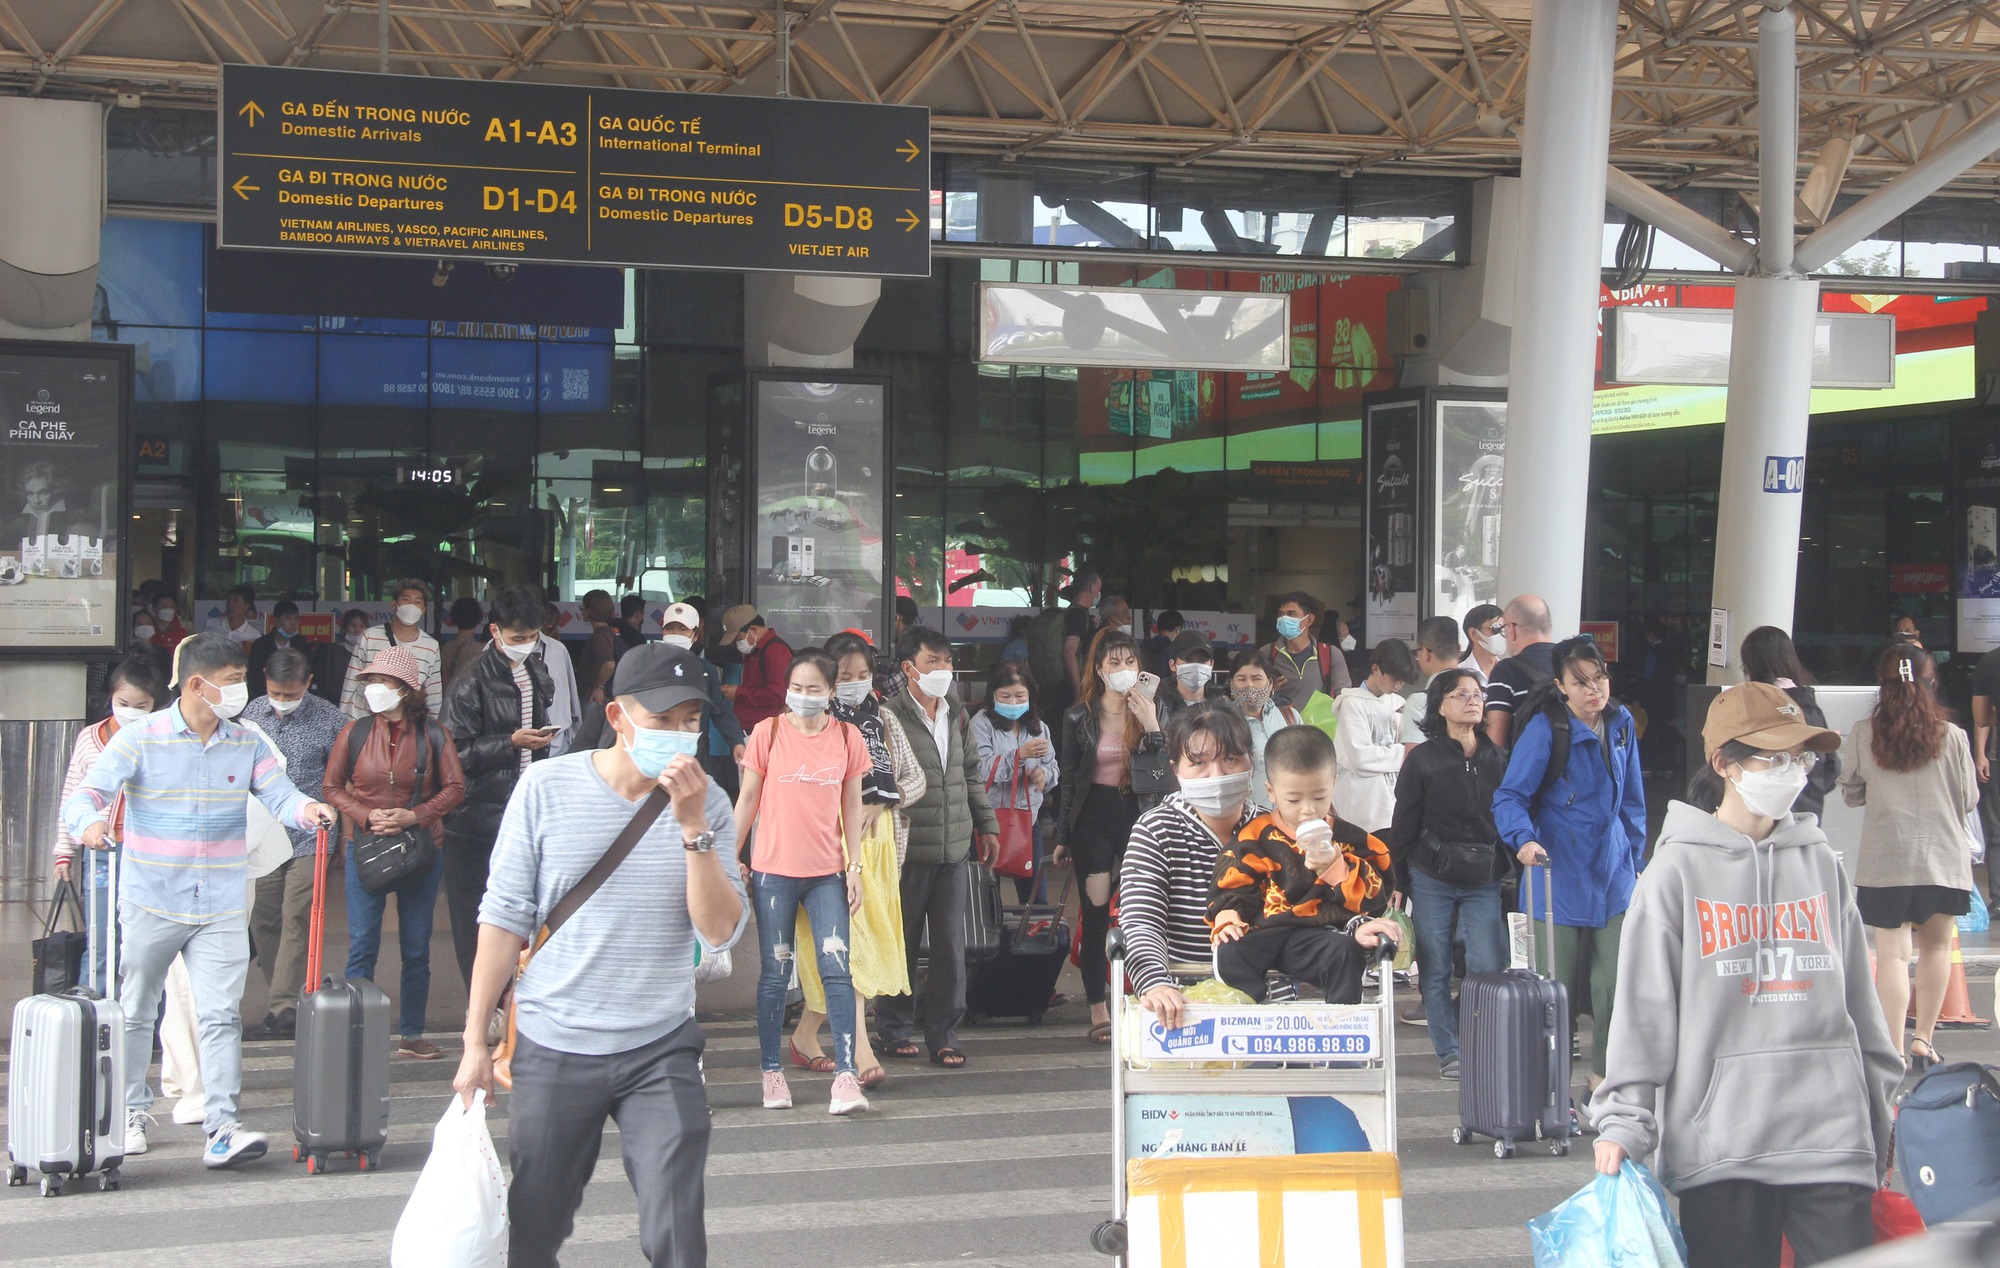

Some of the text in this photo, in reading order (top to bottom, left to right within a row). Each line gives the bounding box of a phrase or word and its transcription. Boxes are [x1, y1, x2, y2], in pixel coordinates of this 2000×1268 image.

[281, 99, 471, 126] GA ĐẾN TRONG NƯỚC
[281, 121, 422, 143] Domestic Arrivals
[484, 118, 577, 147] A1-A3
[599, 114, 701, 135] GA QUỐC TẾ
[599, 136, 761, 156] International Terminal
[278, 168, 448, 191] GA ĐI TRONG NƯỚC
[278, 190, 444, 212] Domestic Departures
[483, 186, 577, 214] D1-D4
[599, 186, 757, 206] GA ĐI TRONG NƯỚC
[599, 206, 754, 225] Domestic Departures
[784, 203, 873, 231] D5-D8
[280, 218, 548, 242] VIETNAM AIRLINES, VASCO, PACIFIC AIRLINES,
[280, 231, 525, 252] BAMBOO AIRWAYS & VIETRAVEL AIRLINES
[789, 243, 870, 258] VIETJET AIR
[26, 403, 60, 415] Legend
[10, 430, 75, 440] PHIN GIAY
[808, 426, 836, 436] Legend
[139, 441, 166, 458] A2
[411, 470, 452, 483] 14:05
[1490, 489, 1497, 499] 8
[1695, 891, 1834, 959] BROOKLYN
[1722, 947, 1832, 982] NEW 07 YORK
[1778, 993, 1808, 1002] STATES
[1220, 1017, 1261, 1026] BIZMAN
[1194, 1034, 1209, 1046] CÁO
[1254, 1037, 1365, 1053] 094.986.98.98
[1141, 1110, 1168, 1120] BIDV
[1177, 1141, 1208, 1153] HÀNG
[1211, 1141, 1233, 1153] BÁN
